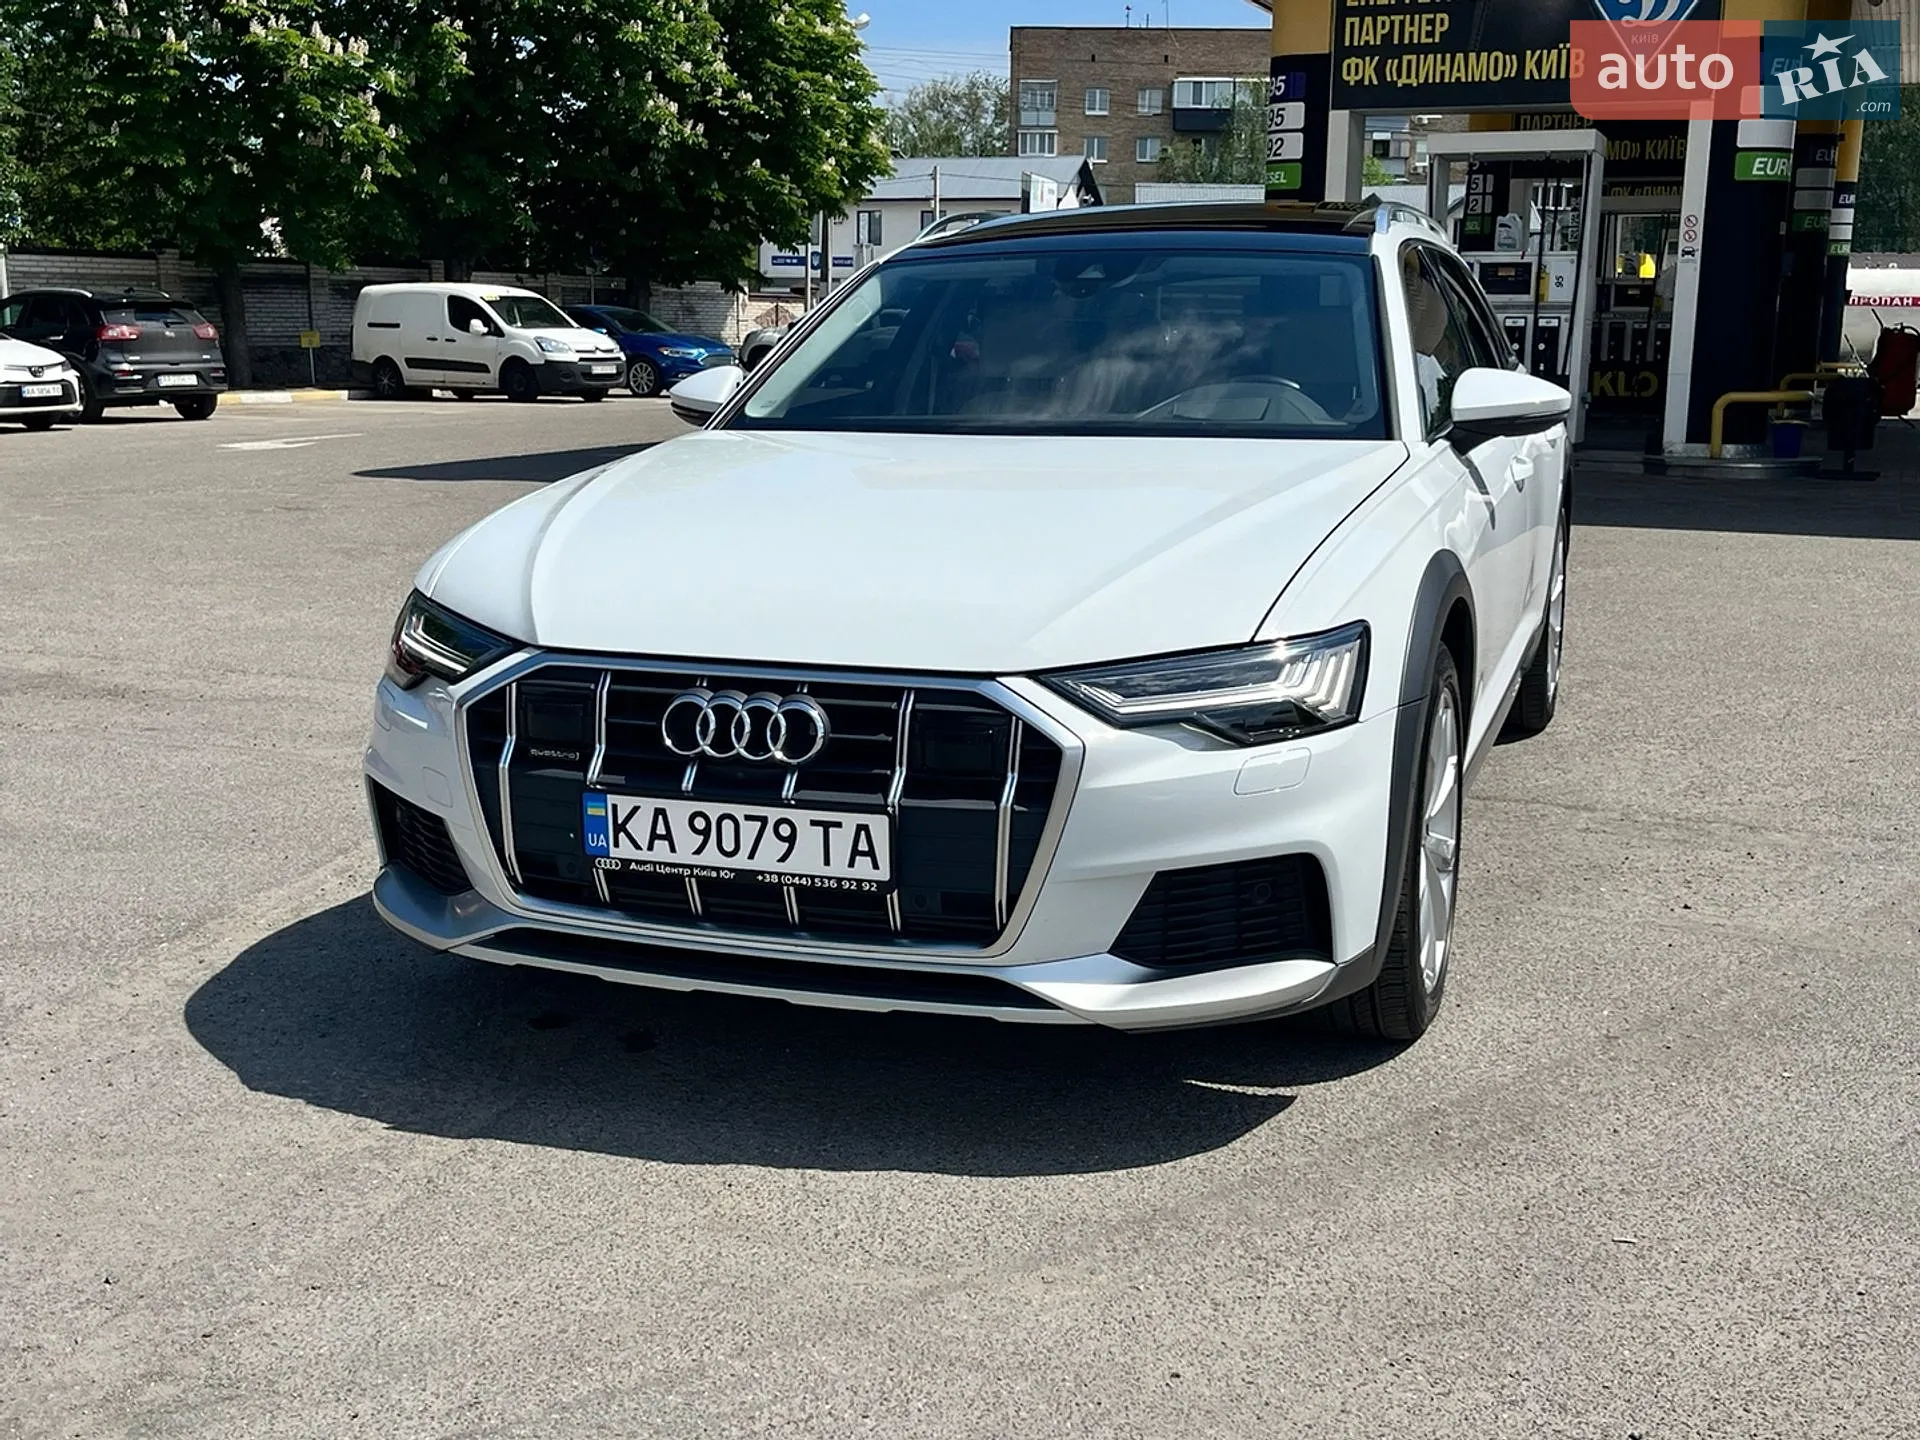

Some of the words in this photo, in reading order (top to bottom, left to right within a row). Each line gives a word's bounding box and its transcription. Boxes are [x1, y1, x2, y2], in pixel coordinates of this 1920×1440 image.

[1344, 13, 1450, 47] ПАРТНЕР
[1342, 56, 1380, 86] ФК
[1385, 51, 1518, 87] «ДИНАМО»
[1524, 43, 1586, 80] КИЇВ
[1645, 136, 1687, 160] КИЇВ
[1848, 296, 1913, 306] ПРОПАН
[588, 833, 608, 848] UA
[611, 803, 678, 855] KA
[687, 810, 798, 863] 9079
[809, 819, 881, 871] TA
[629, 862, 655, 872] Audi
[656, 865, 691, 877] Центр
[693, 868, 718, 878] Київ
[719, 870, 736, 880] Юг
[756, 873, 779, 883] +38
[781, 875, 812, 886] (044)
[814, 877, 838, 889] 536
[841, 880, 858, 890] 92
[861, 882, 878, 892] 92
